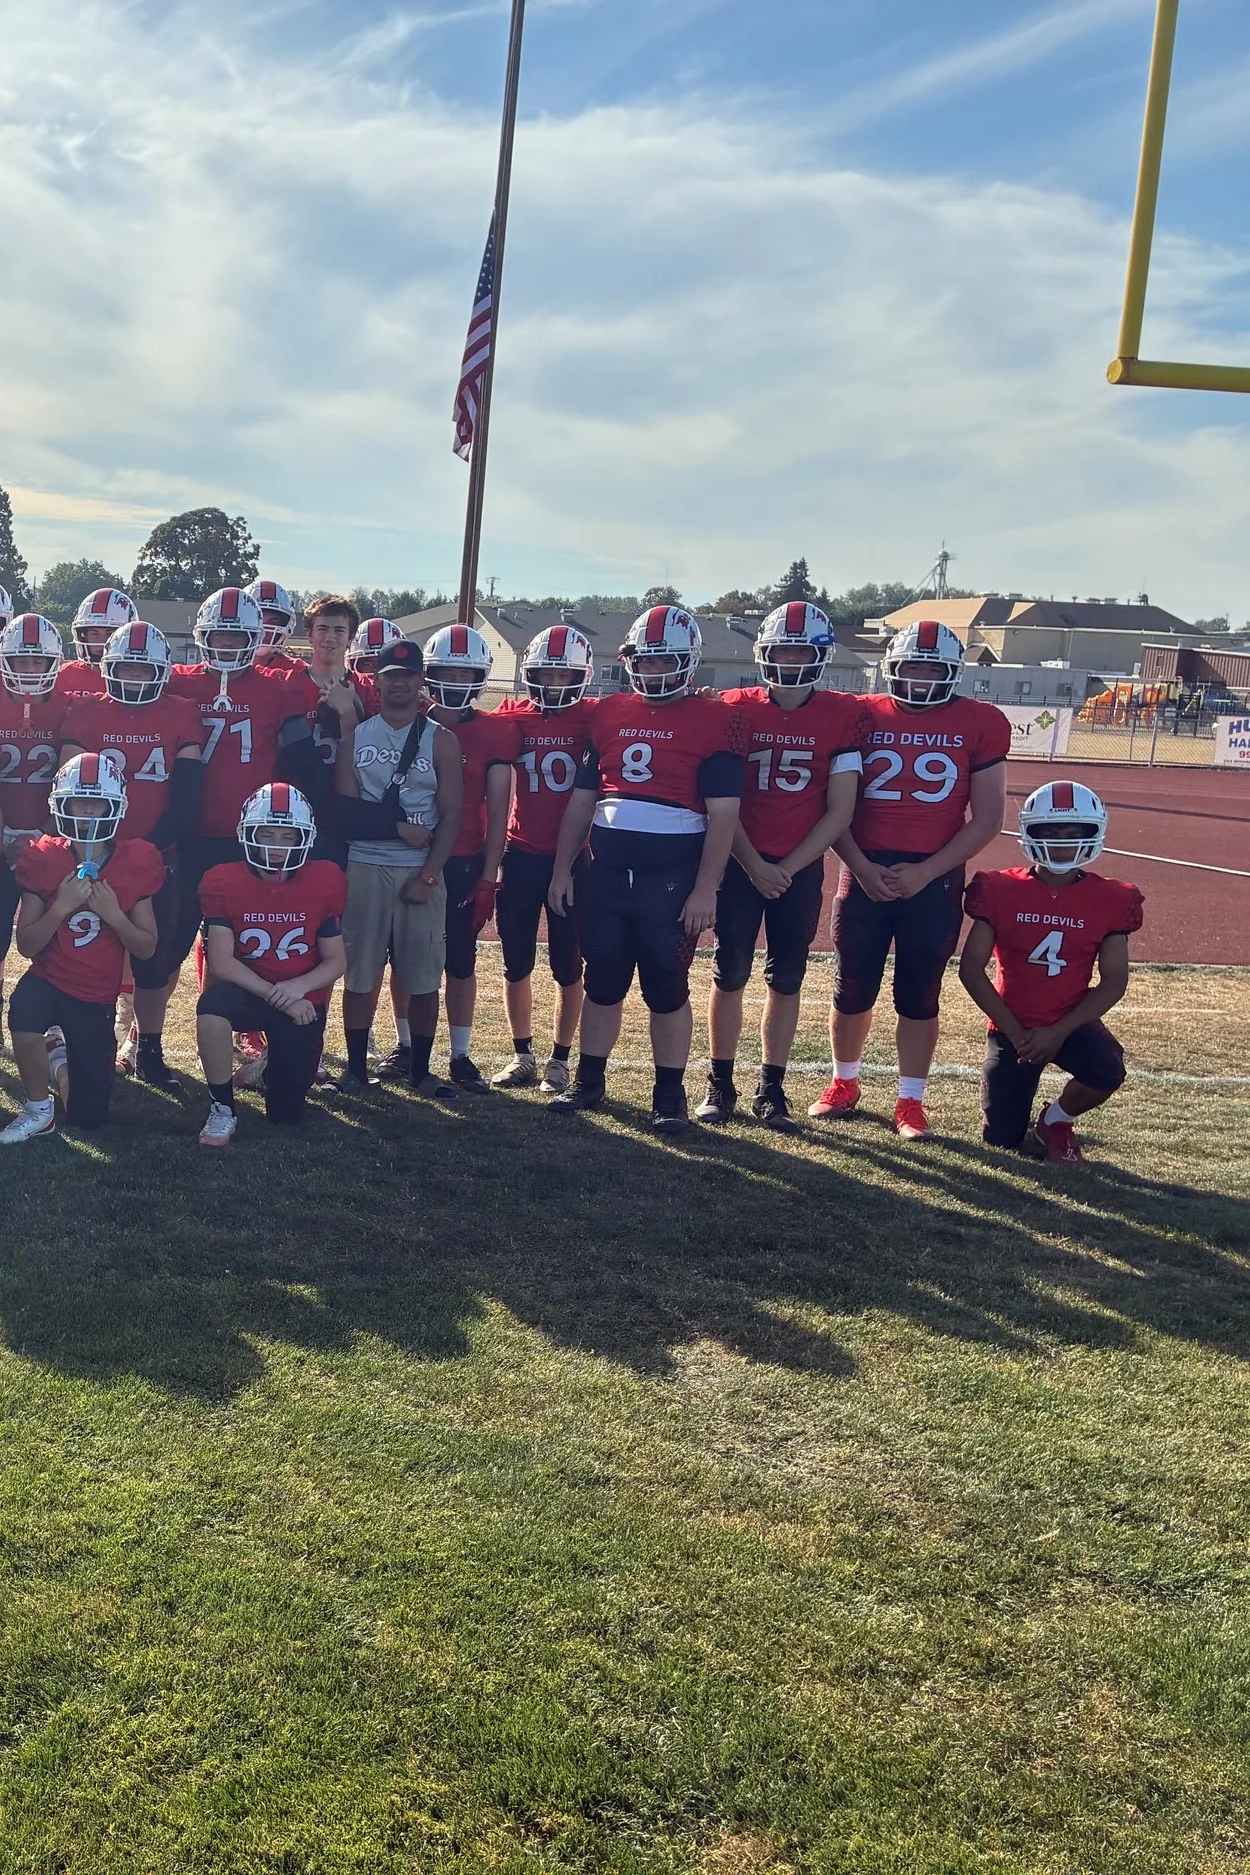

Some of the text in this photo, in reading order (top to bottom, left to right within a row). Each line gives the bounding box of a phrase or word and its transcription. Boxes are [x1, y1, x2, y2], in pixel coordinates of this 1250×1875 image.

[198, 704, 216, 712] ED
[0, 730, 17, 738] RED
[103, 734, 161, 744] RED DEVILS
[201, 717, 252, 764] 71
[524, 737, 574, 745] ED DEVILS
[618, 728, 674, 740] RED DEVILS
[752, 732, 816, 746] RED DEVILS
[900, 733, 963, 748] DEVILS
[1229, 738, 1250, 748] HA
[620, 742, 654, 783] 8
[747, 748, 814, 792] 15
[515, 750, 577, 792] 10
[862, 750, 958, 803] 29
[244, 912, 306, 922] RED DEVILS
[1016, 912, 1085, 929] RED DEVILS
[66, 910, 101, 948] 9
[240, 927, 308, 960] 26
[1027, 930, 1068, 977] 4
